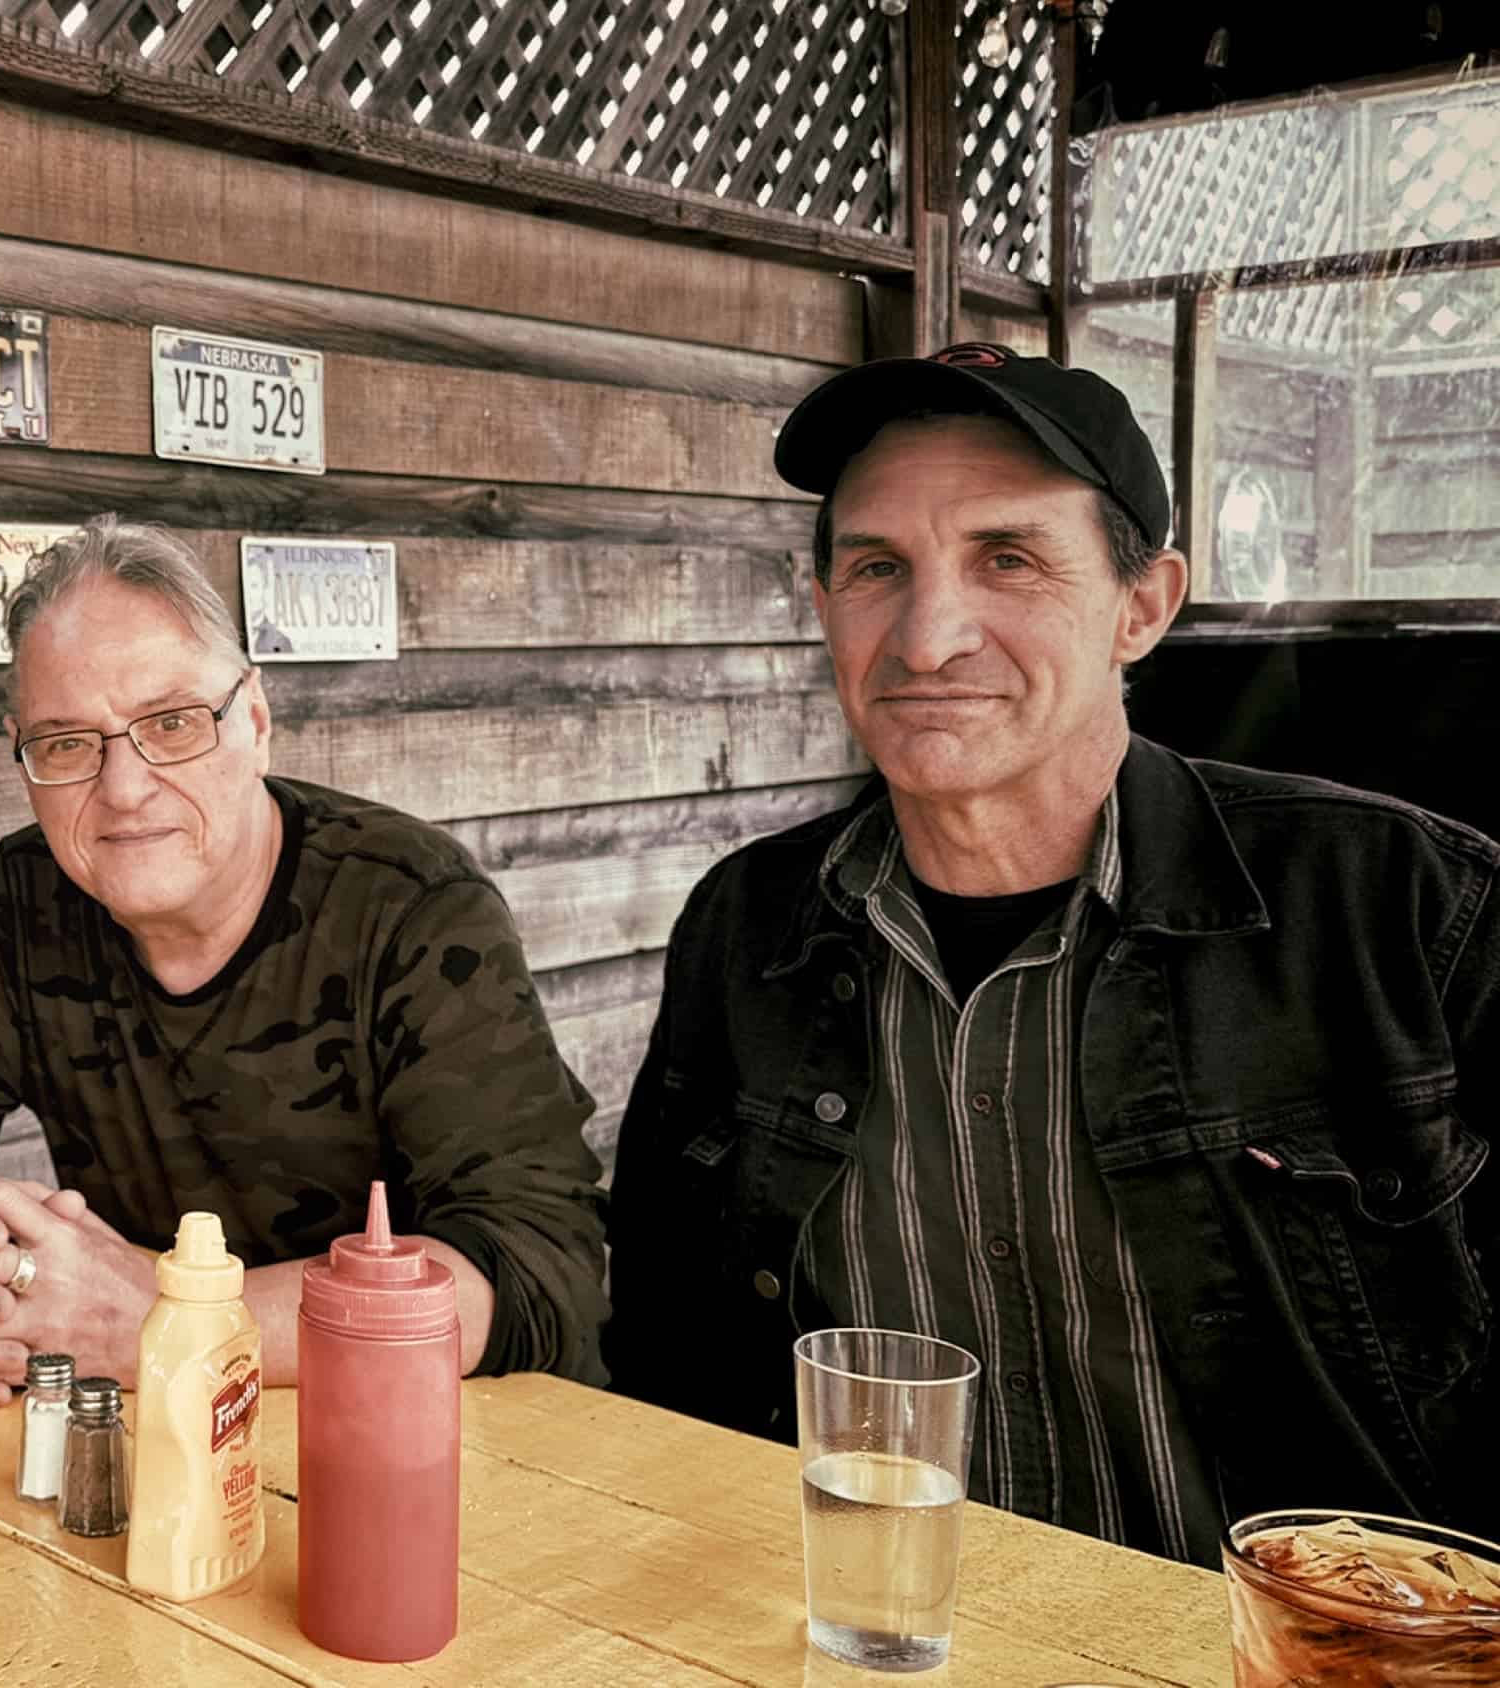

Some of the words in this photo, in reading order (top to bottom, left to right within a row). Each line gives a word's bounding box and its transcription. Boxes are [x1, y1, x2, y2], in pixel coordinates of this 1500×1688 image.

[200, 345, 279, 374] NEBRASKA
[174, 367, 229, 430] VIB
[252, 380, 305, 439] 529
[284, 545, 359, 562] ILLINOIS
